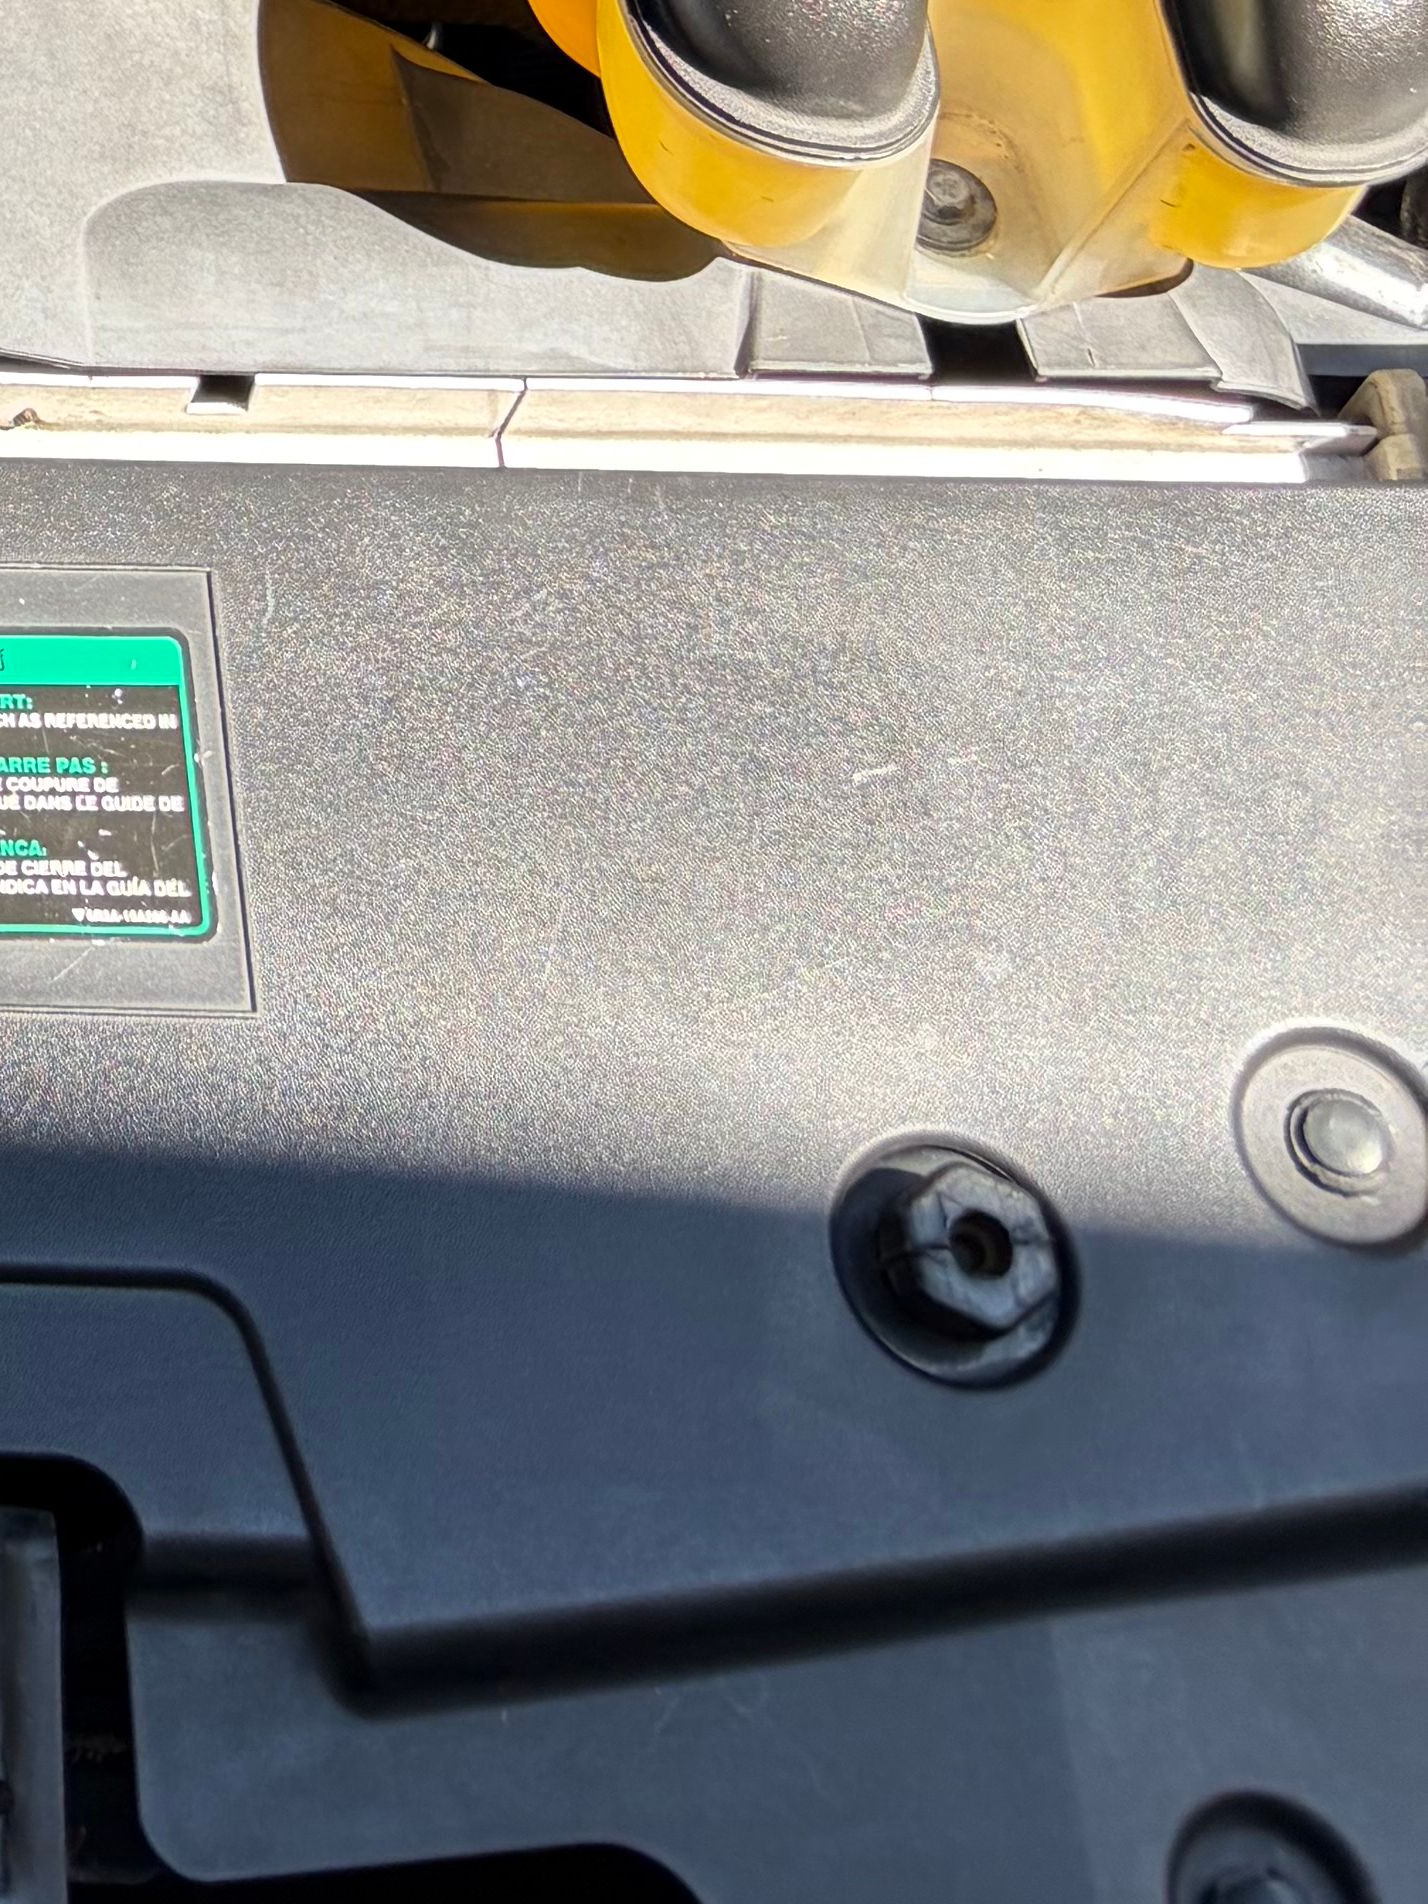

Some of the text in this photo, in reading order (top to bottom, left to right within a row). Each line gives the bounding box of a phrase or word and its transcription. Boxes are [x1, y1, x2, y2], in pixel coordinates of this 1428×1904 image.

[18, 712, 42, 729] AS
[44, 712, 156, 730] REFERENCED
[158, 713, 178, 730] IN
[56, 756, 96, 774] PAS
[6, 776, 90, 792] COUPURE
[94, 777, 119, 793] DE
[24, 794, 73, 811] DANS
[75, 794, 99, 811] LE
[101, 795, 156, 812] GUIDE
[158, 795, 185, 812] DE
[21, 860, 88, 876] CIERRE
[90, 861, 127, 878] DEL
[51, 879, 77, 896] EN
[79, 879, 105, 896] LA
[154, 877, 192, 897] DEL
